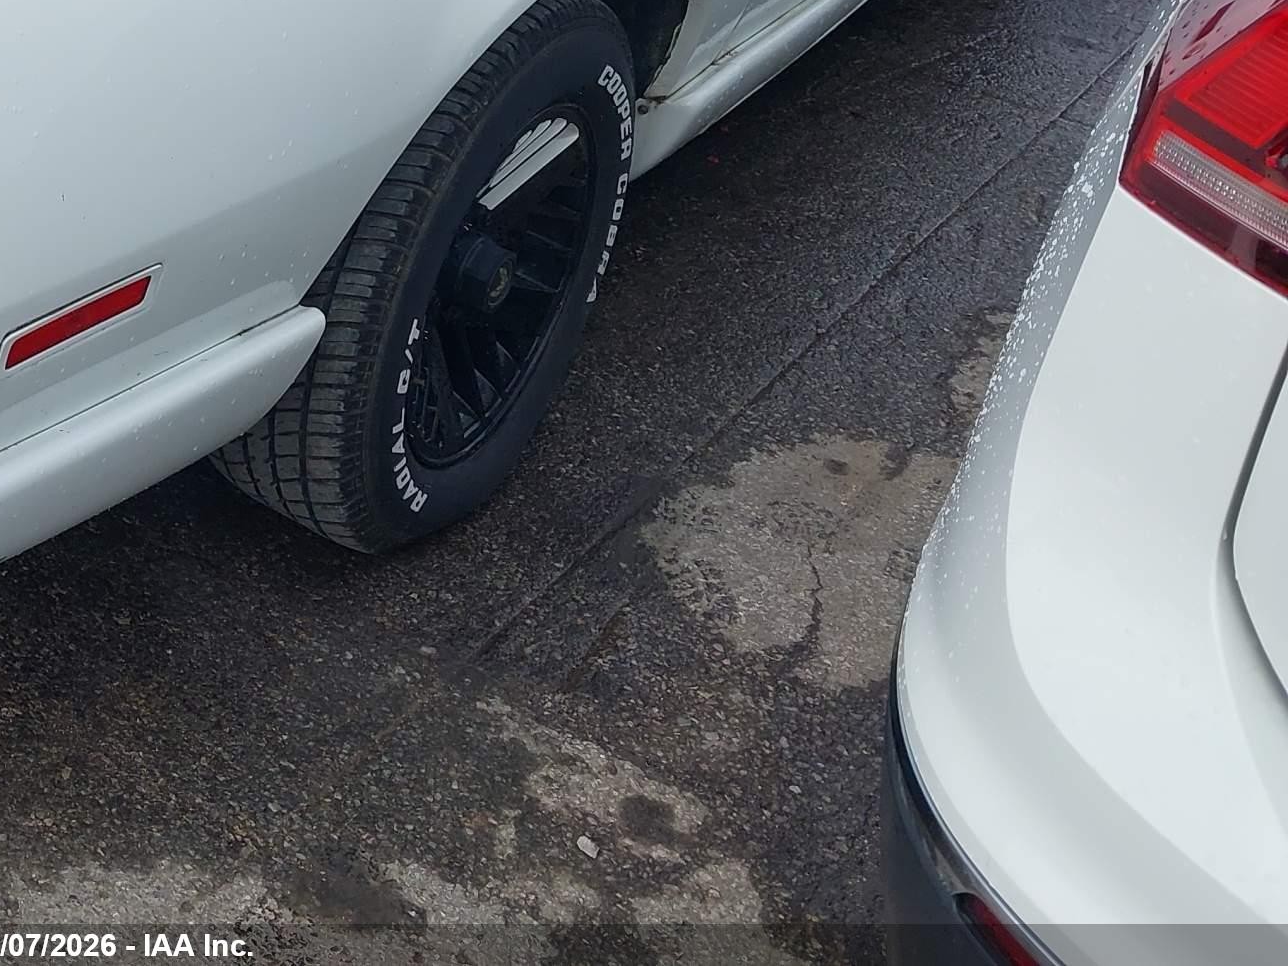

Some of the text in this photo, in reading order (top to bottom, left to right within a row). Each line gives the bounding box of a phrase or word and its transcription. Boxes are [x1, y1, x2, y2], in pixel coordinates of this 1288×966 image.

[586, 64, 633, 303] COOPER COBRA
[391, 318, 428, 513] RADIAL G/T
